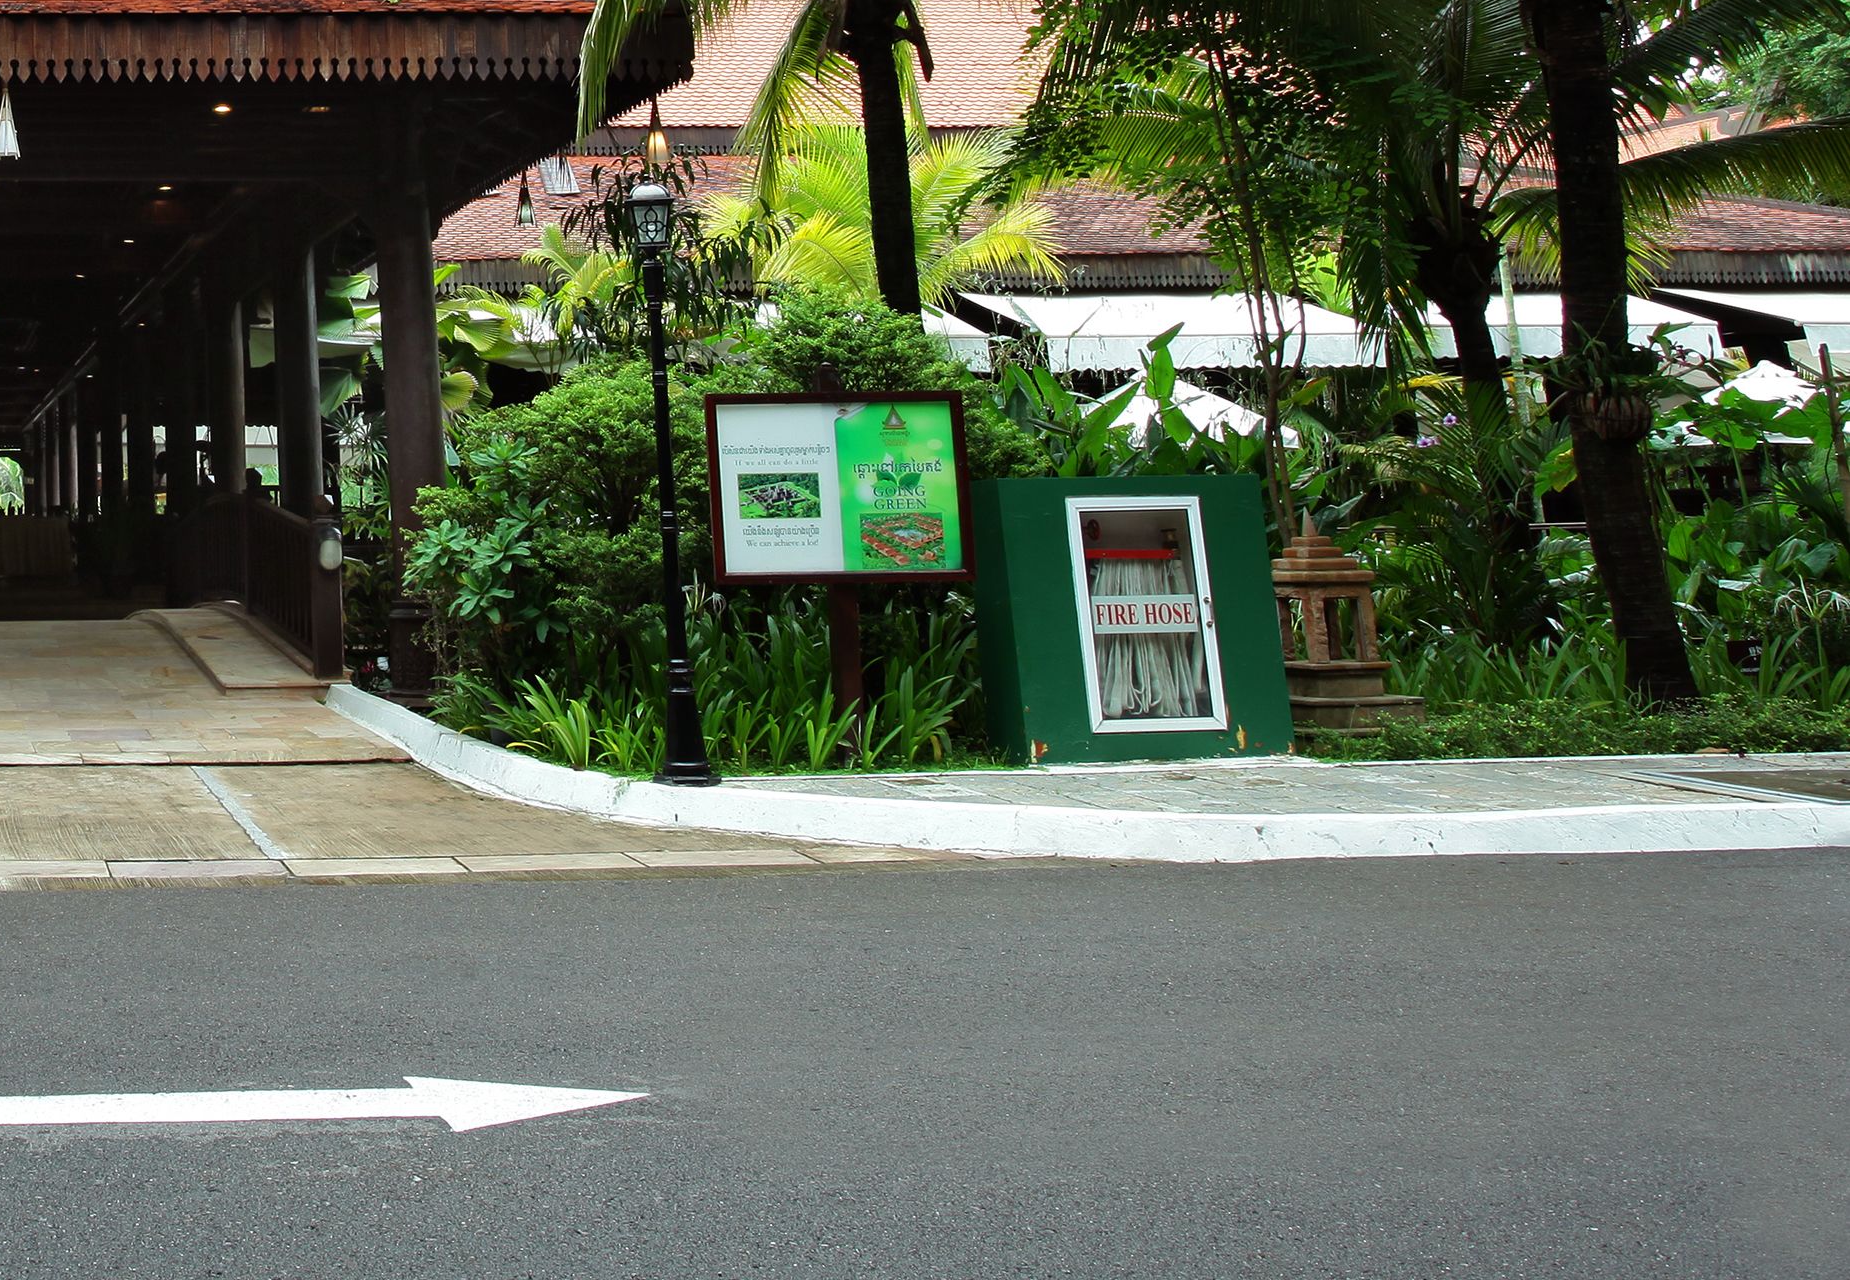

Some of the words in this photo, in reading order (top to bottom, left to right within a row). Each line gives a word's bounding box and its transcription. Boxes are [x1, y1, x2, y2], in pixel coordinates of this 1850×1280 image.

[873, 484, 926, 497] GOING
[874, 498, 927, 510] GREEN
[746, 539, 758, 547] We
[773, 539, 800, 547] achieve
[1095, 603, 1139, 626] FIRE
[1143, 602, 1196, 625] HOSE
